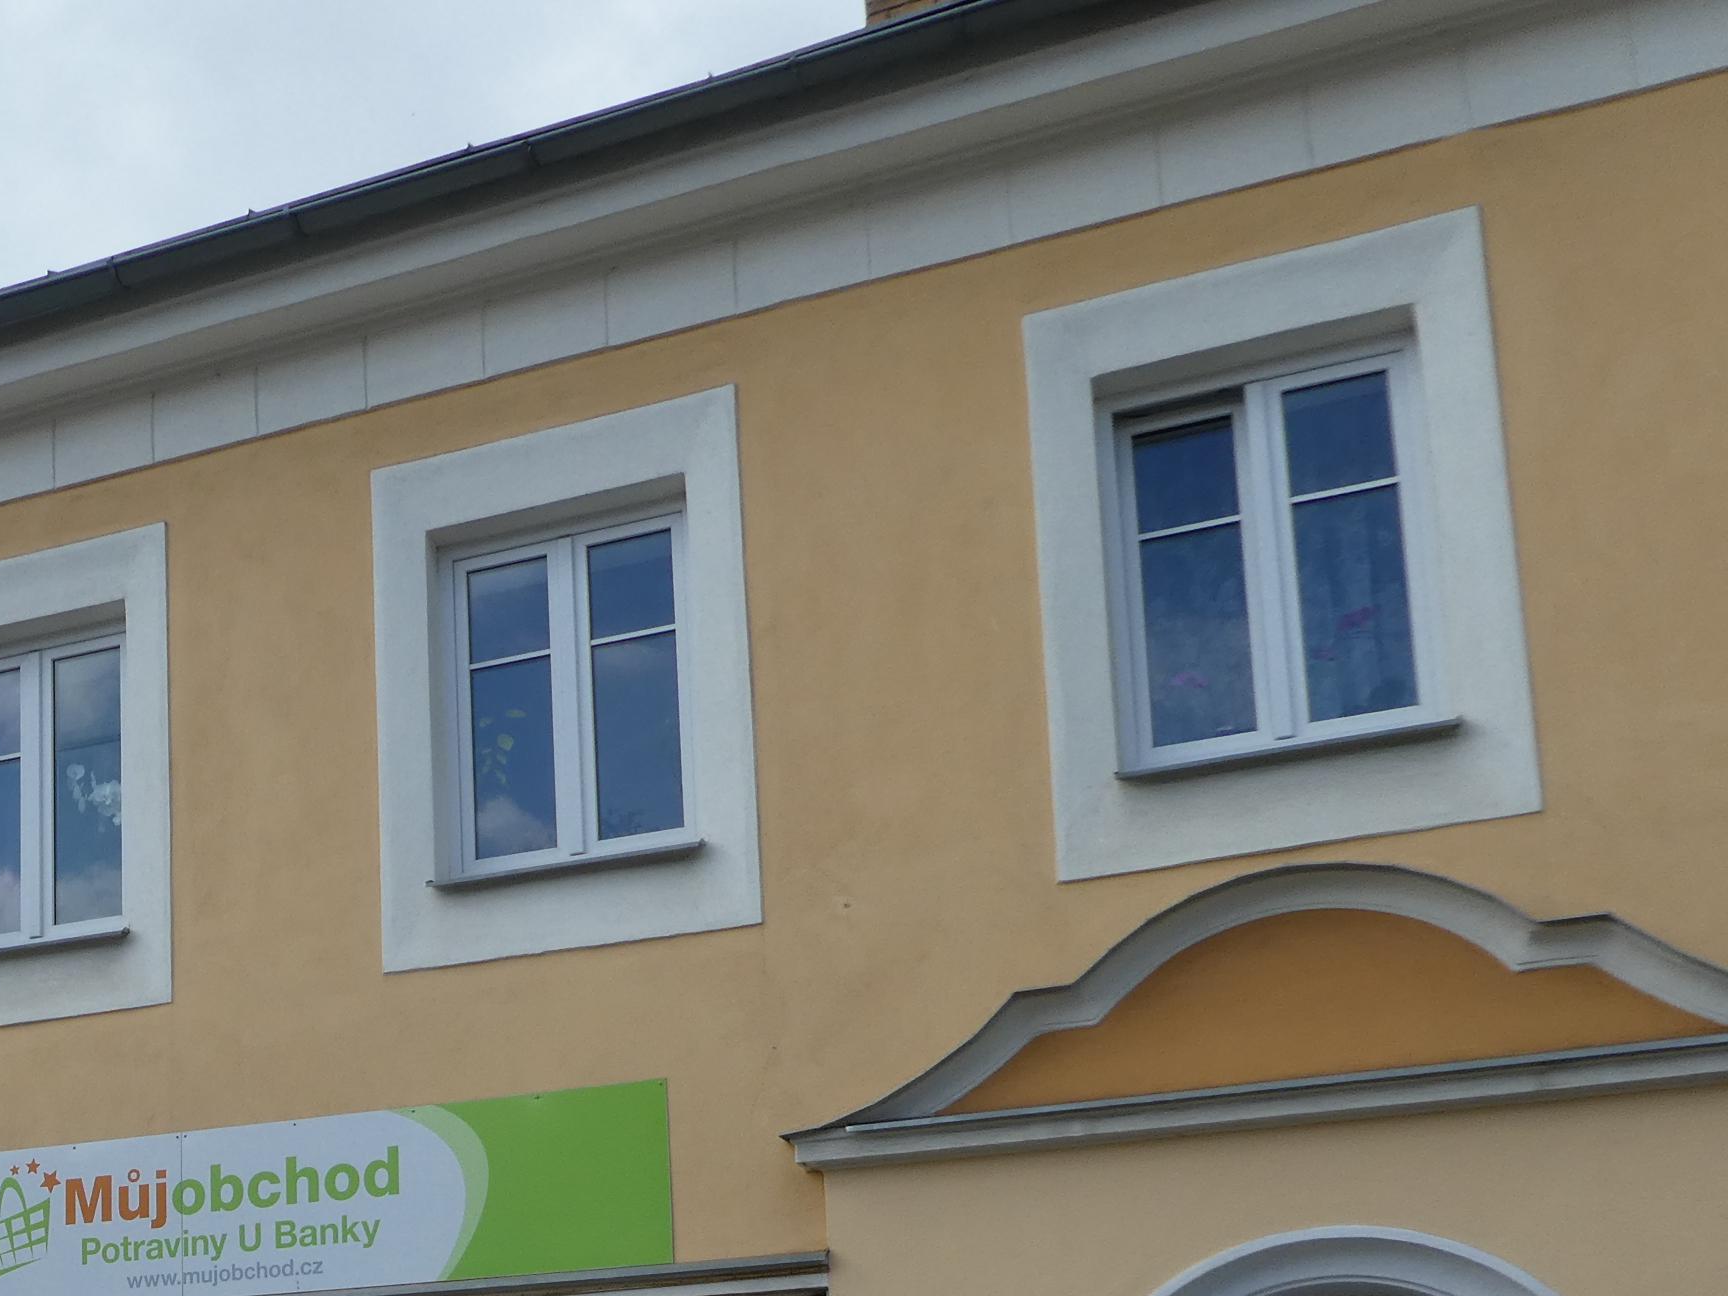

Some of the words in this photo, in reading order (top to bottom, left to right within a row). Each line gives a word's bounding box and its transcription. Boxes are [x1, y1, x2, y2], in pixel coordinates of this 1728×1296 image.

[81, 1230, 228, 1265] Potraviny
[238, 1222, 262, 1252] U
[275, 1215, 381, 1249] Banky
[126, 1258, 323, 1289] www.mujobchod.cz
